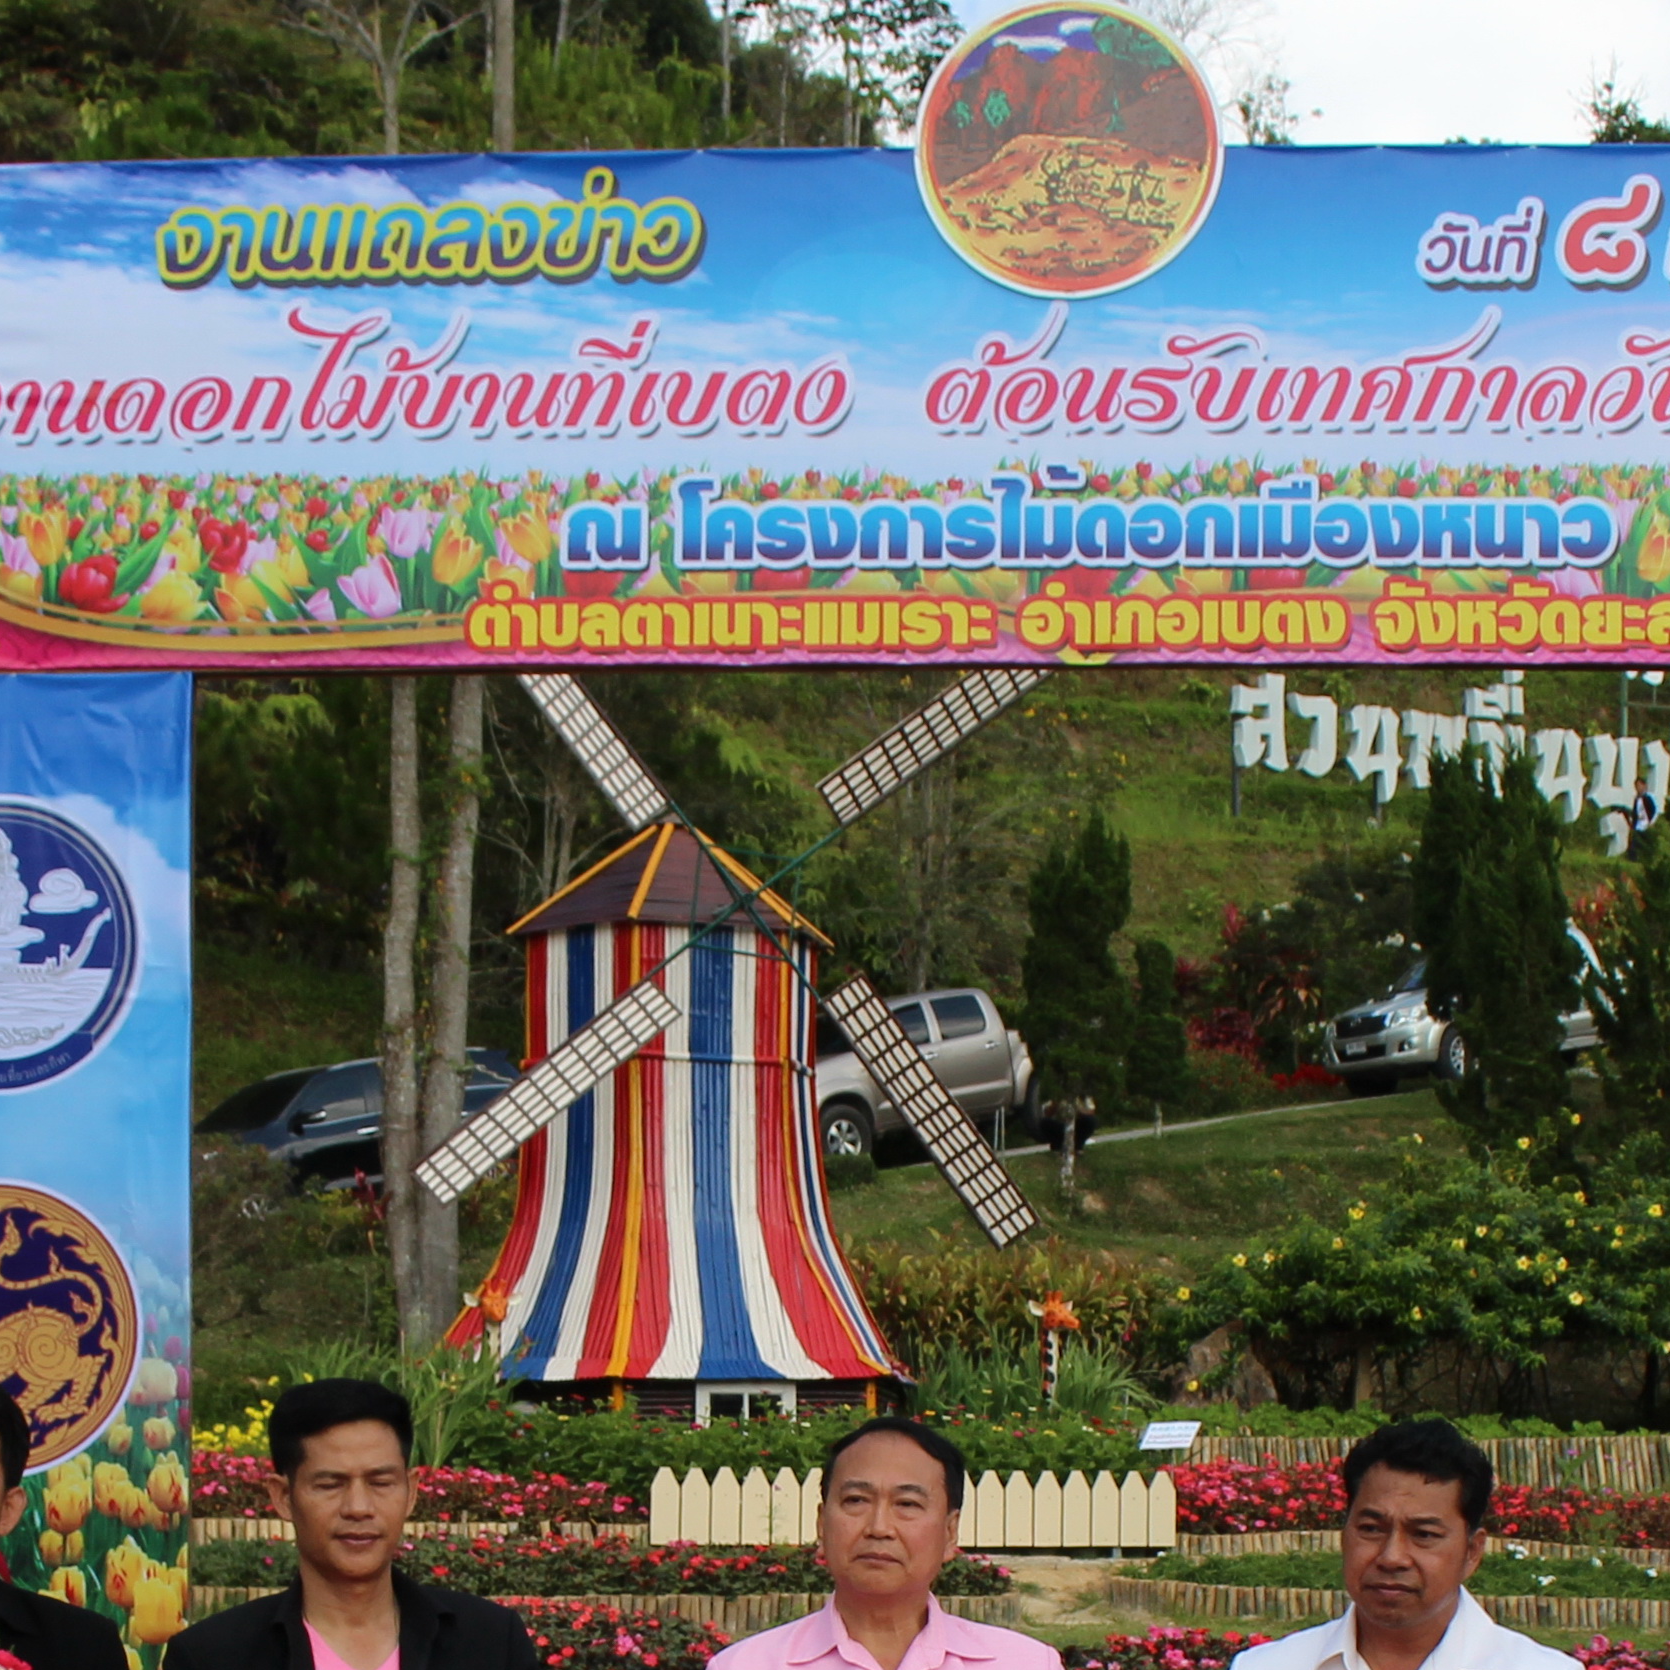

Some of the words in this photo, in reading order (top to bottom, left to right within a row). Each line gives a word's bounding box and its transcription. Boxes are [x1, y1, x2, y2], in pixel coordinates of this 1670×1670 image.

[157, 166, 703, 286] งานแถลงข่าว
[1423, 203, 1538, 280] วันที่
[1562, 181, 1650, 276] ๘
[564, 500, 644, 566] ณ
[676, 465, 1613, 564] โครงการไม้ดอกเมืองหนาว
[468, 582, 995, 650] ตำบลตาเนาะแมเราะ
[1020, 580, 1348, 648] อำเภอเบตง
